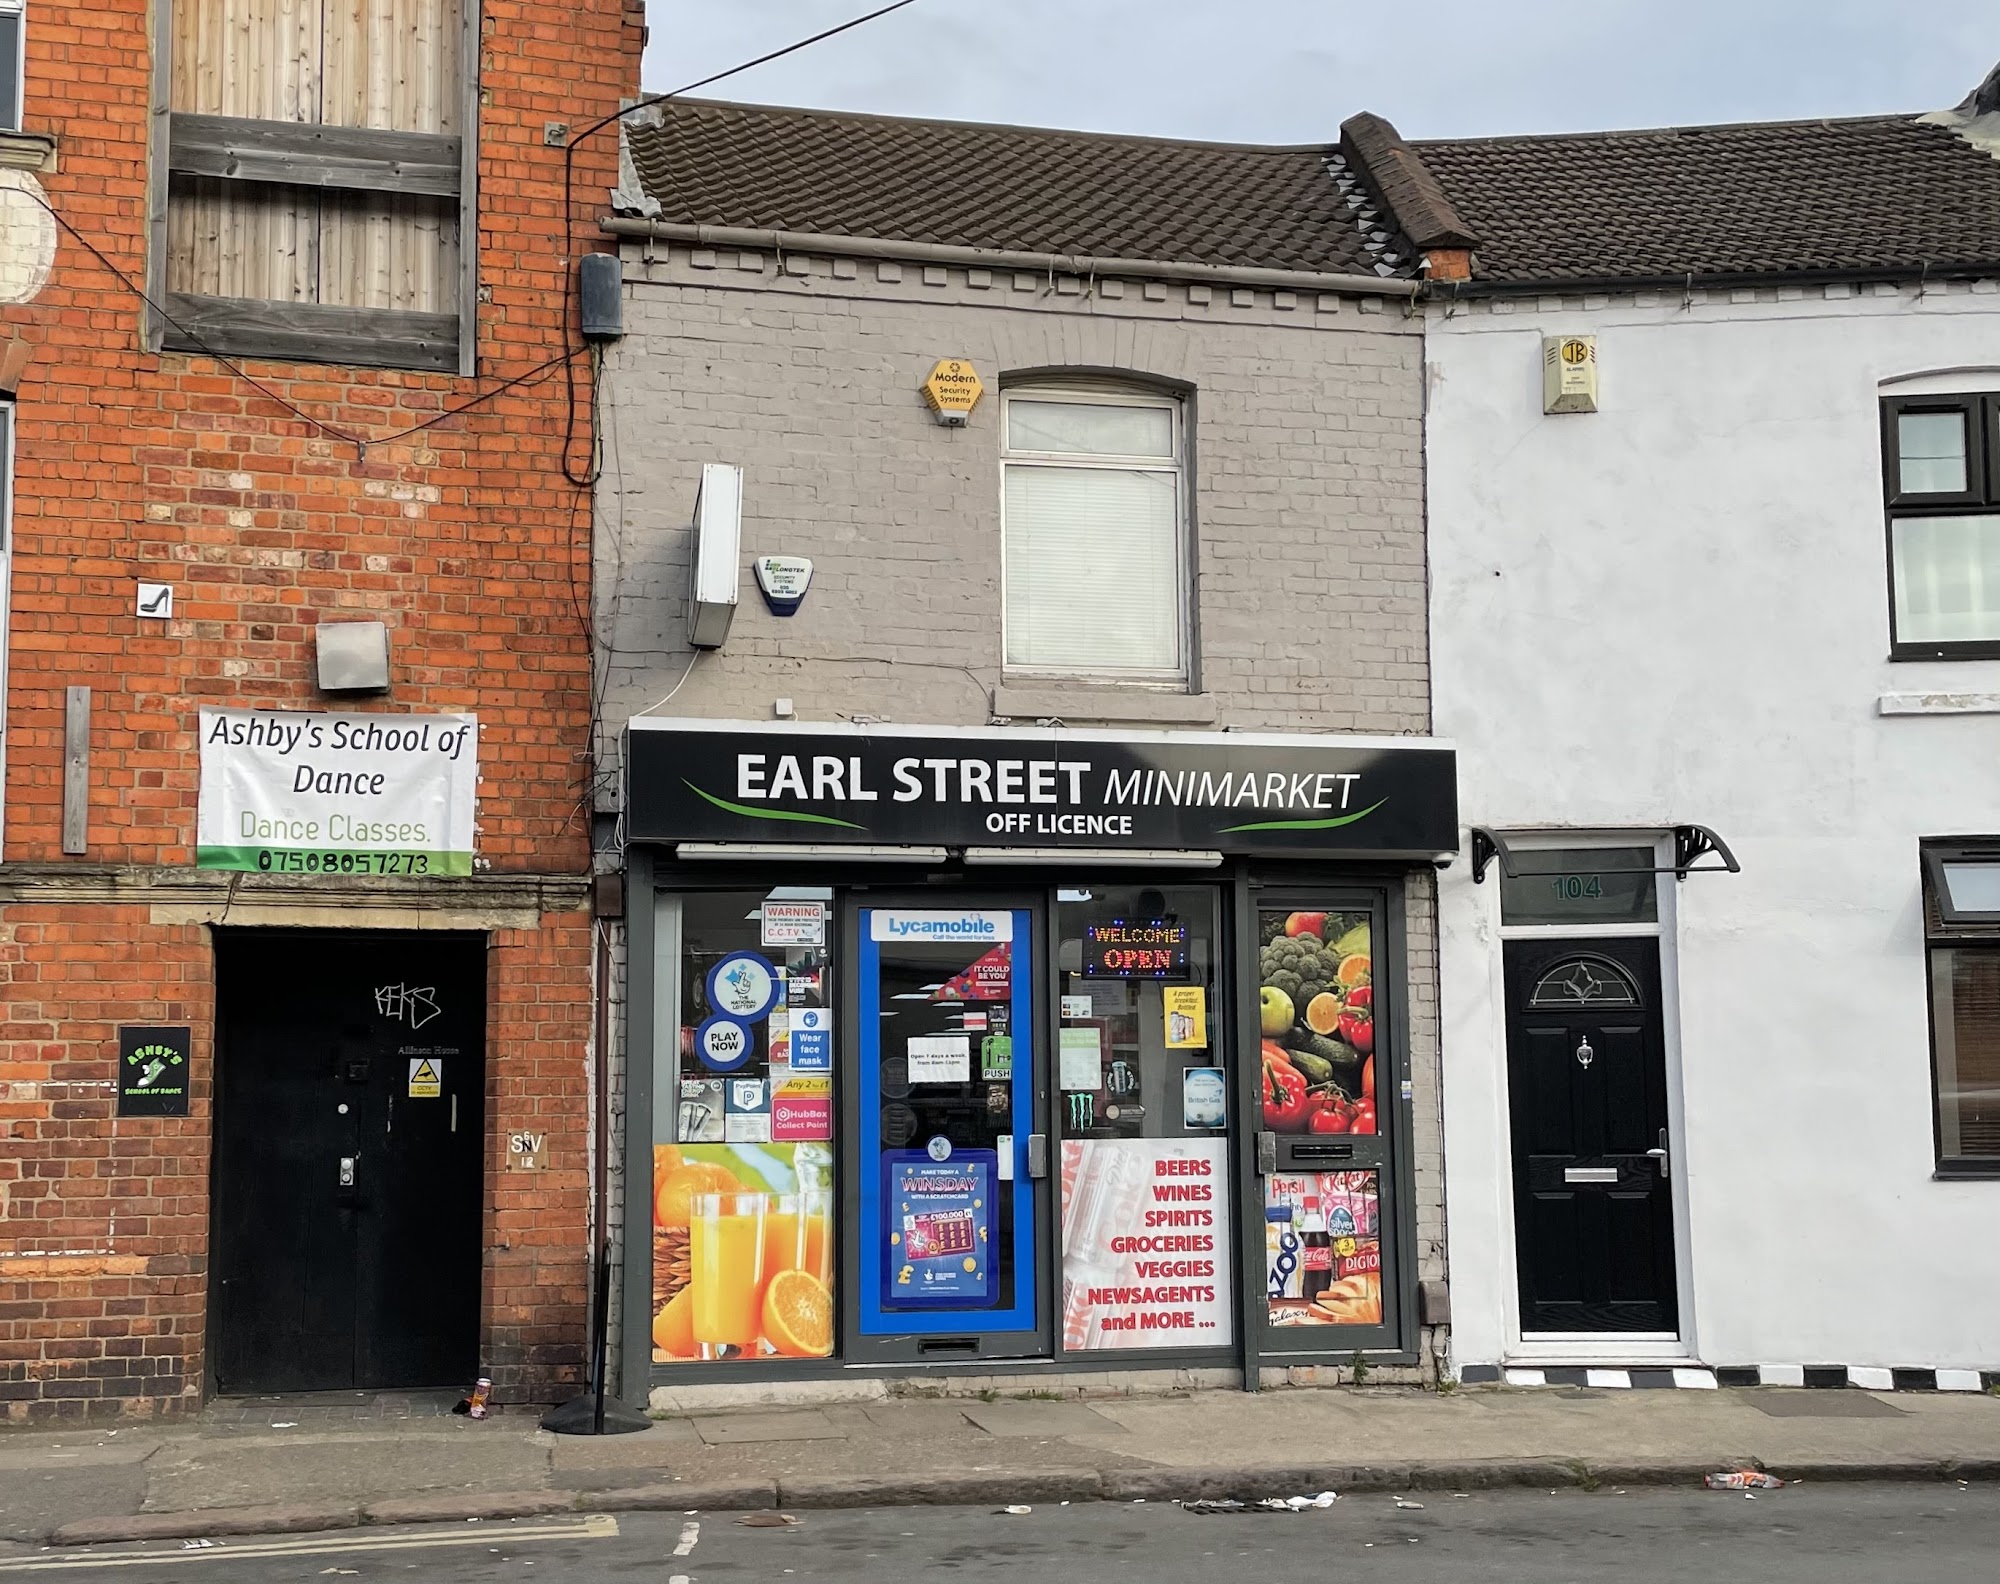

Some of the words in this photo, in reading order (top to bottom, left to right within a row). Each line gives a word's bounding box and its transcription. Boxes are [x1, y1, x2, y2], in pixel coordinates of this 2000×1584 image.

[1566, 342, 1584, 362] JB
[935, 372, 976, 384] Modern
[940, 386, 970, 396] Security
[940, 395, 970, 404] Systems
[208, 716, 324, 755] Ashby's
[331, 721, 430, 751] School
[438, 724, 470, 760] of
[293, 765, 385, 795] Dance
[737, 754, 878, 800] EARL
[892, 757, 1091, 804] STREET
[1103, 768, 1360, 810] MINIMARKET
[241, 811, 319, 840] Dance
[329, 814, 432, 843] Classes.
[985, 812, 1030, 833] OFF
[1038, 814, 1132, 835] LICENCE
[258, 850, 428, 874] 07508057273
[1552, 874, 1602, 900] 104
[767, 908, 820, 916] WARNING
[889, 916, 994, 936] Lycamobile
[1094, 928, 1180, 944] WELCOME
[1103, 948, 1172, 968] OPEN
[711, 1032, 738, 1042] PLAY
[799, 1034, 821, 1042] Wear
[127, 1045, 182, 1065] ASHBY'S
[712, 1042, 738, 1051] NOW
[800, 1044, 820, 1054] face
[798, 1056, 822, 1065] mask
[786, 1080, 804, 1089] Any
[790, 1110, 828, 1118] HubBox
[776, 1121, 804, 1129] Collect
[1155, 1159, 1211, 1176] BEERS
[900, 1177, 979, 1192] WINSDAY
[1152, 1184, 1212, 1201] WINES
[1272, 1178, 1305, 1198] Persil
[1145, 1210, 1213, 1227] SPIRITS
[1330, 1218, 1355, 1229] silver
[1111, 1235, 1214, 1253] GROCERIES
[1135, 1260, 1214, 1278] VEGGIES
[1088, 1286, 1215, 1305] NEWSAGENTS
[1101, 1313, 1136, 1330] and
[1140, 1312, 1194, 1329] MORE
